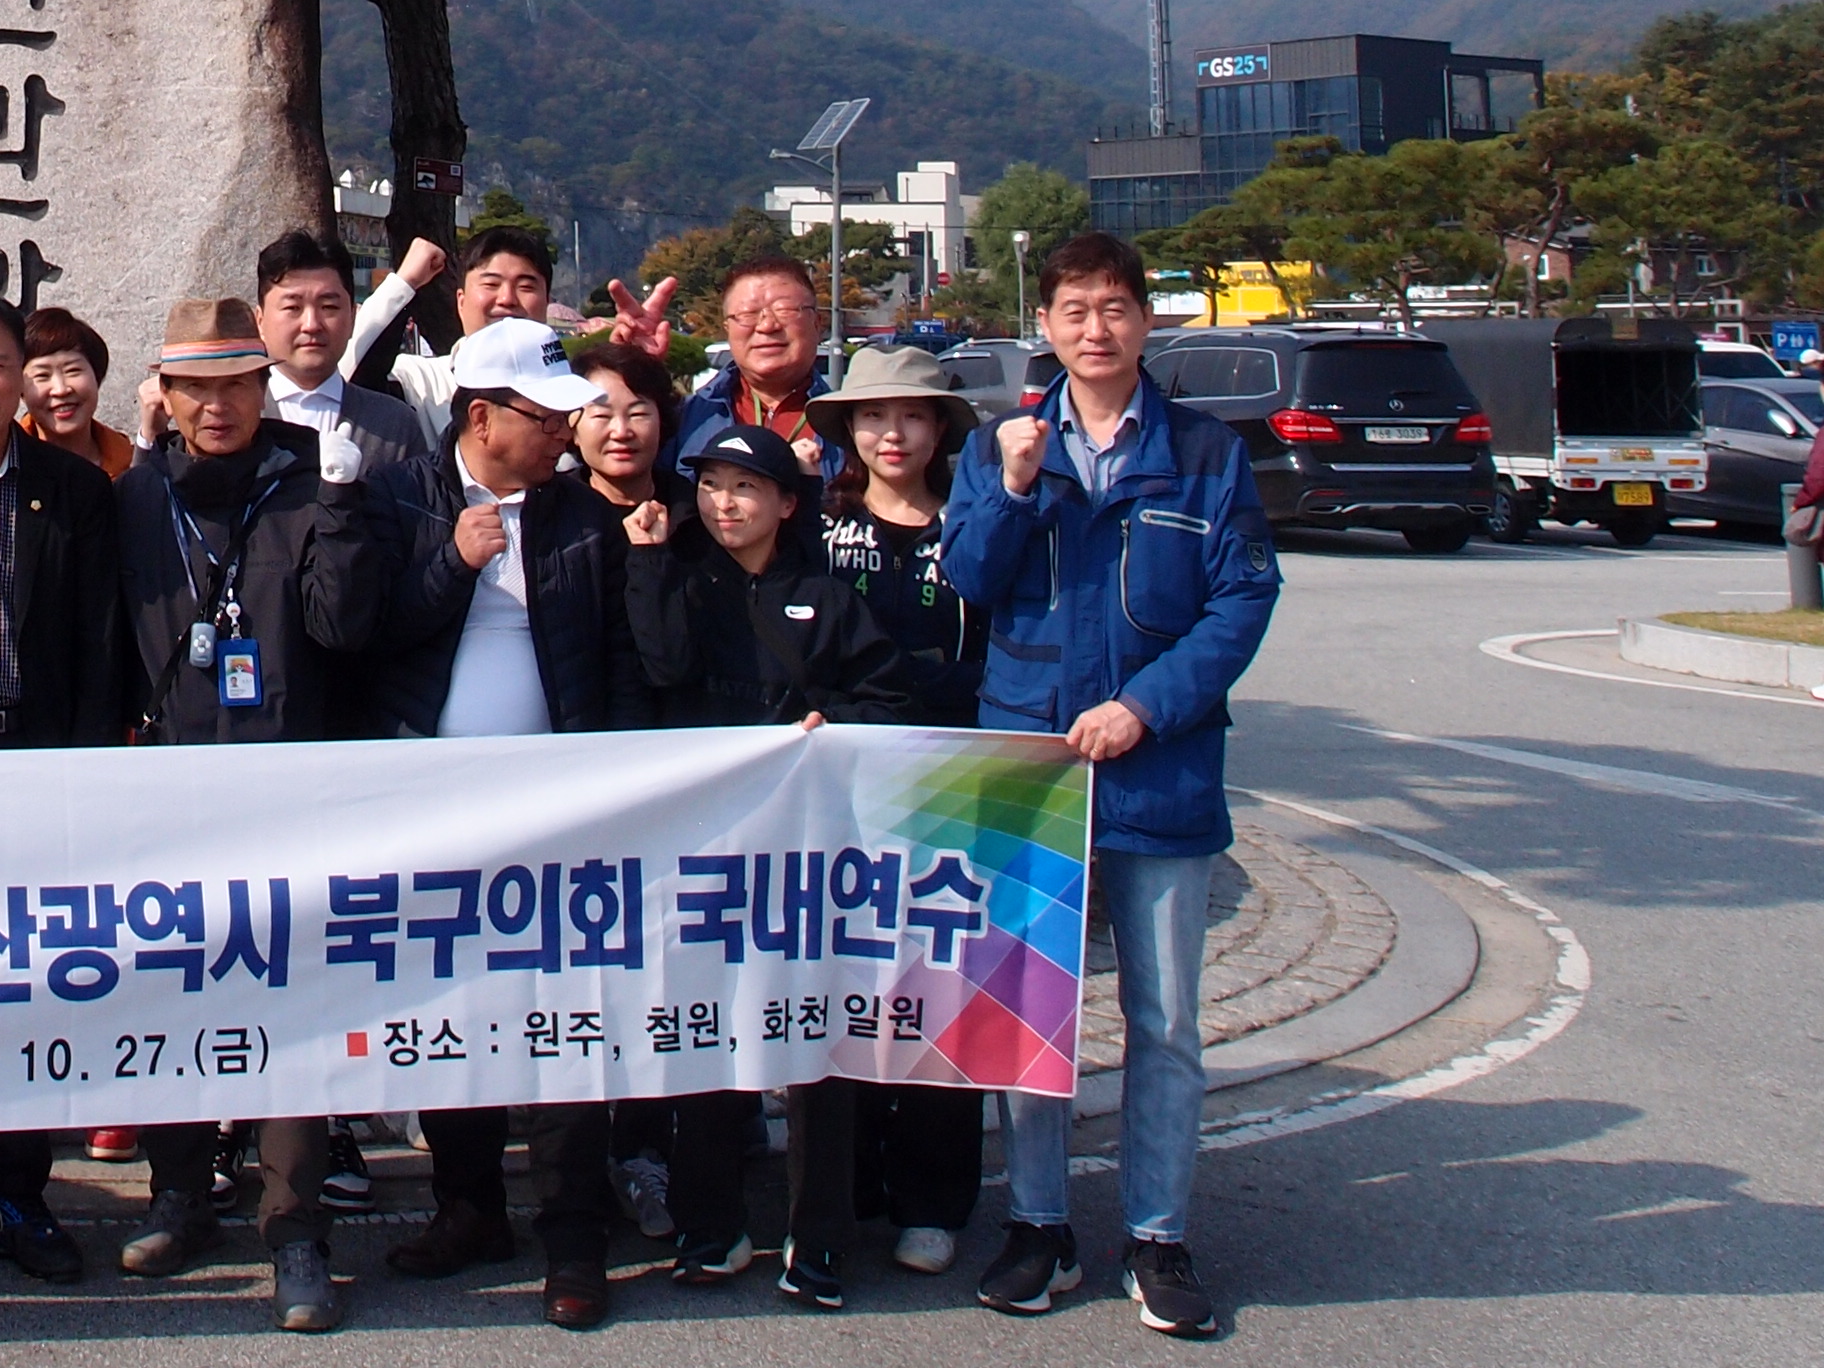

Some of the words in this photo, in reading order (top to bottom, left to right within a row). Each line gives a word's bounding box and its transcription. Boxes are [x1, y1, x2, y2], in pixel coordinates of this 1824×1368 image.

[1210, 55, 1255, 77] GS25
[1777, 333, 1788, 347] P
[835, 548, 881, 572] WHO
[855, 573, 868, 596] 4
[921, 584, 935, 607] 9
[325, 857, 644, 982] 북구의회
[677, 846, 982, 964] 국내연수
[381, 1018, 466, 1067] 장소
[523, 1009, 621, 1060] 원주,
[645, 1000, 737, 1052] 철원,
[762, 994, 831, 1044] 화천
[844, 992, 924, 1042] 일원
